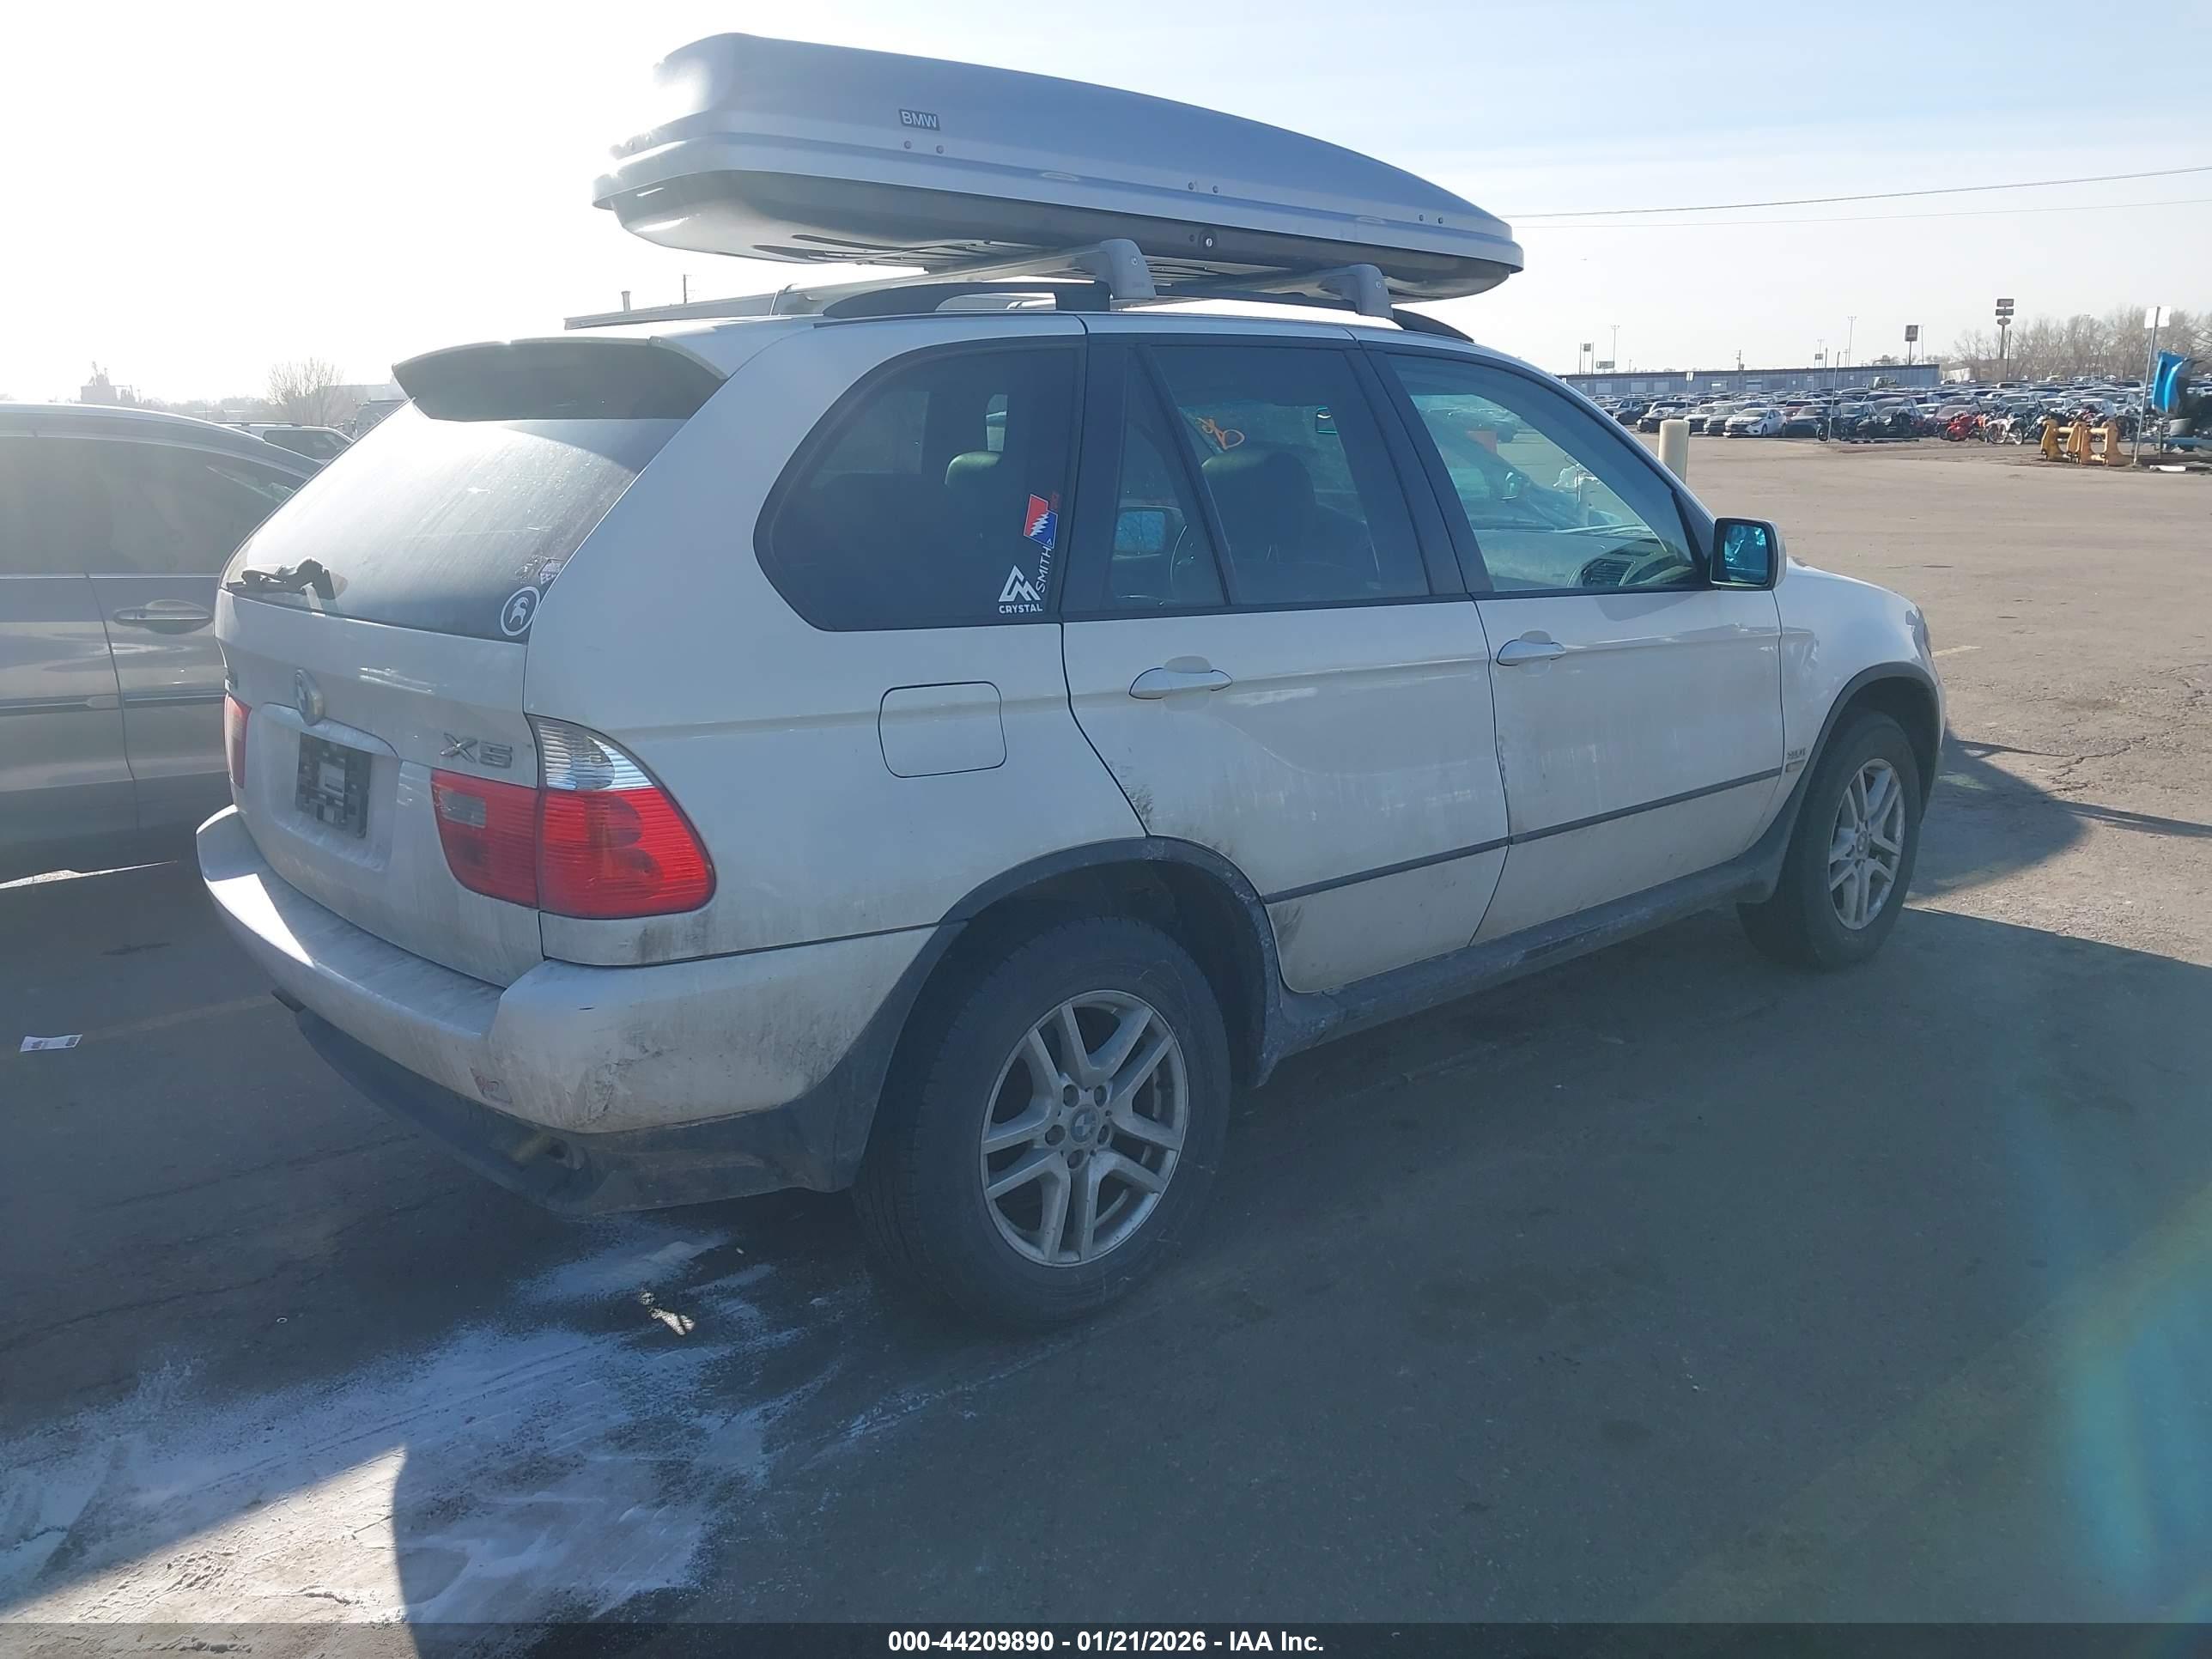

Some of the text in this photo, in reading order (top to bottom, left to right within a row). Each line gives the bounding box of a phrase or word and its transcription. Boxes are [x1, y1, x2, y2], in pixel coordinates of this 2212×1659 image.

[901, 111, 937, 128] BMW
[1036, 544, 1052, 593] SMITH
[999, 603, 1043, 614] CRYSTAL
[440, 732, 513, 769] X5
